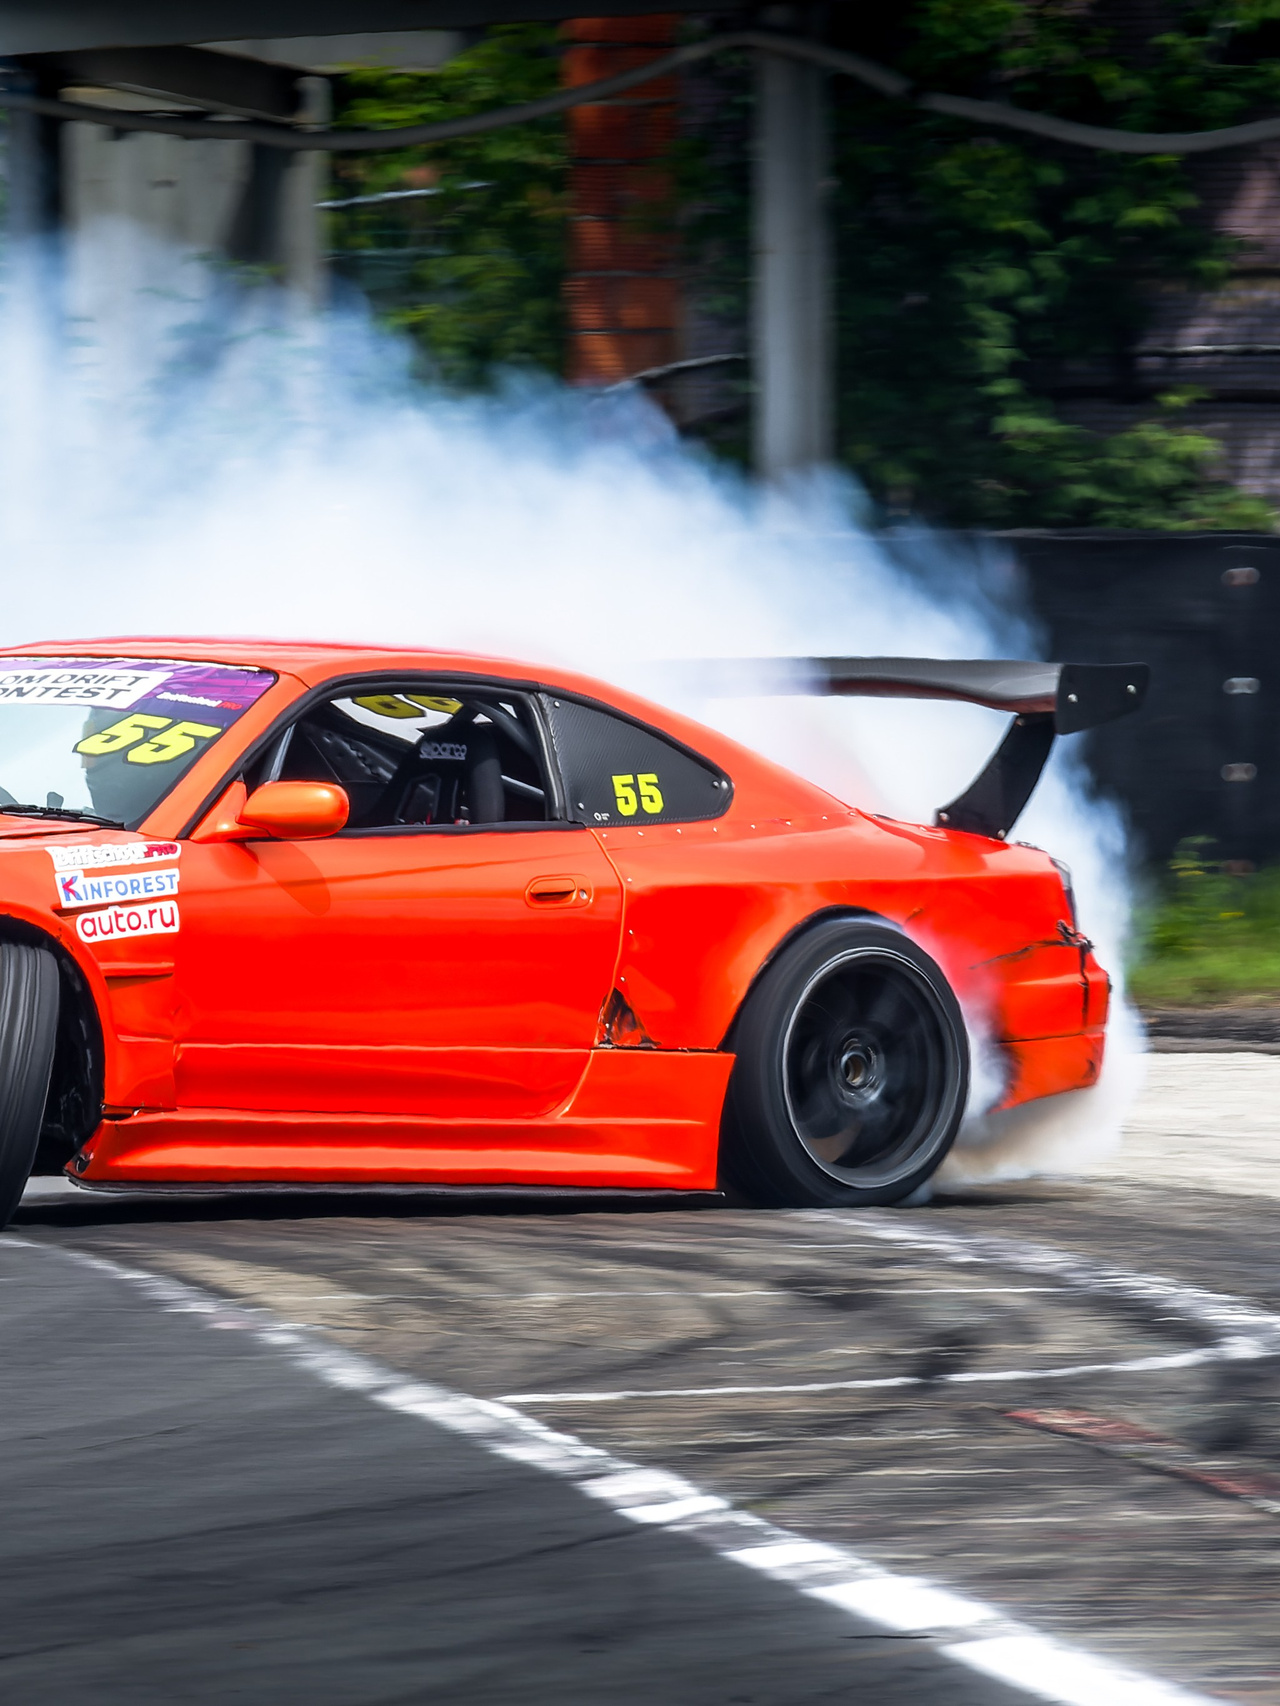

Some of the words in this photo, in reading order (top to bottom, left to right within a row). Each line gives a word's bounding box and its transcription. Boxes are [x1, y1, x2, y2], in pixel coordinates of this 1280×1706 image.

[51, 674, 149, 687] DRIFT
[74, 712, 222, 765] 55
[611, 773, 664, 817] 55
[60, 874, 176, 902] KINFOREST
[81, 907, 175, 937] auto.ru
